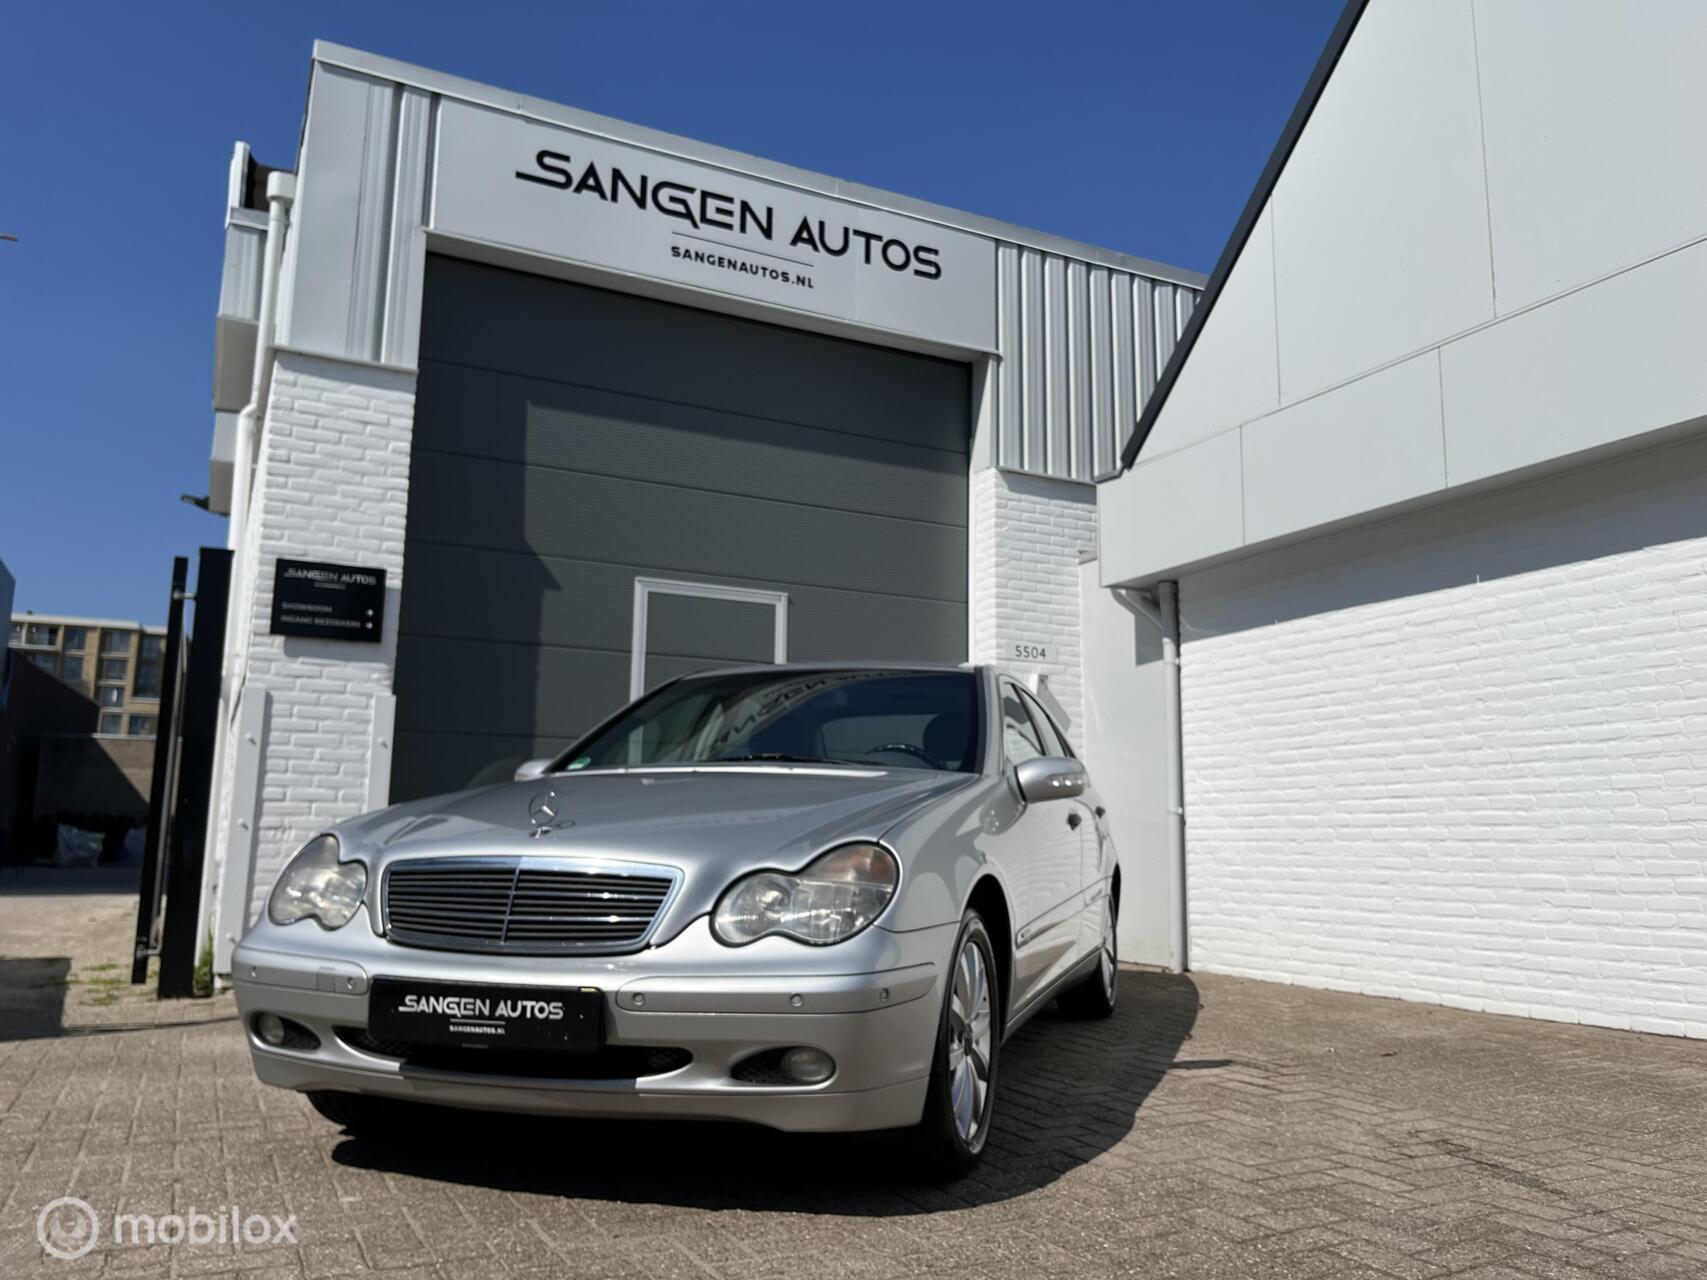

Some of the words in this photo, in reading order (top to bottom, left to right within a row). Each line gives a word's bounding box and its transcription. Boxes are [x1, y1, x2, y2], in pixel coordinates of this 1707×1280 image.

[515, 149, 774, 241] SANGEN
[789, 215, 943, 281] AUTOS
[670, 245, 815, 289] SANGENAUTOS.NL
[284, 567, 338, 582] SANGEN
[341, 573, 377, 586] AUTOS
[1015, 645, 1046, 660] 5504
[398, 994, 490, 1018] SANGEN
[494, 1000, 564, 1021] AUTOS
[449, 1024, 506, 1035] SANGENAUTOS.NL
